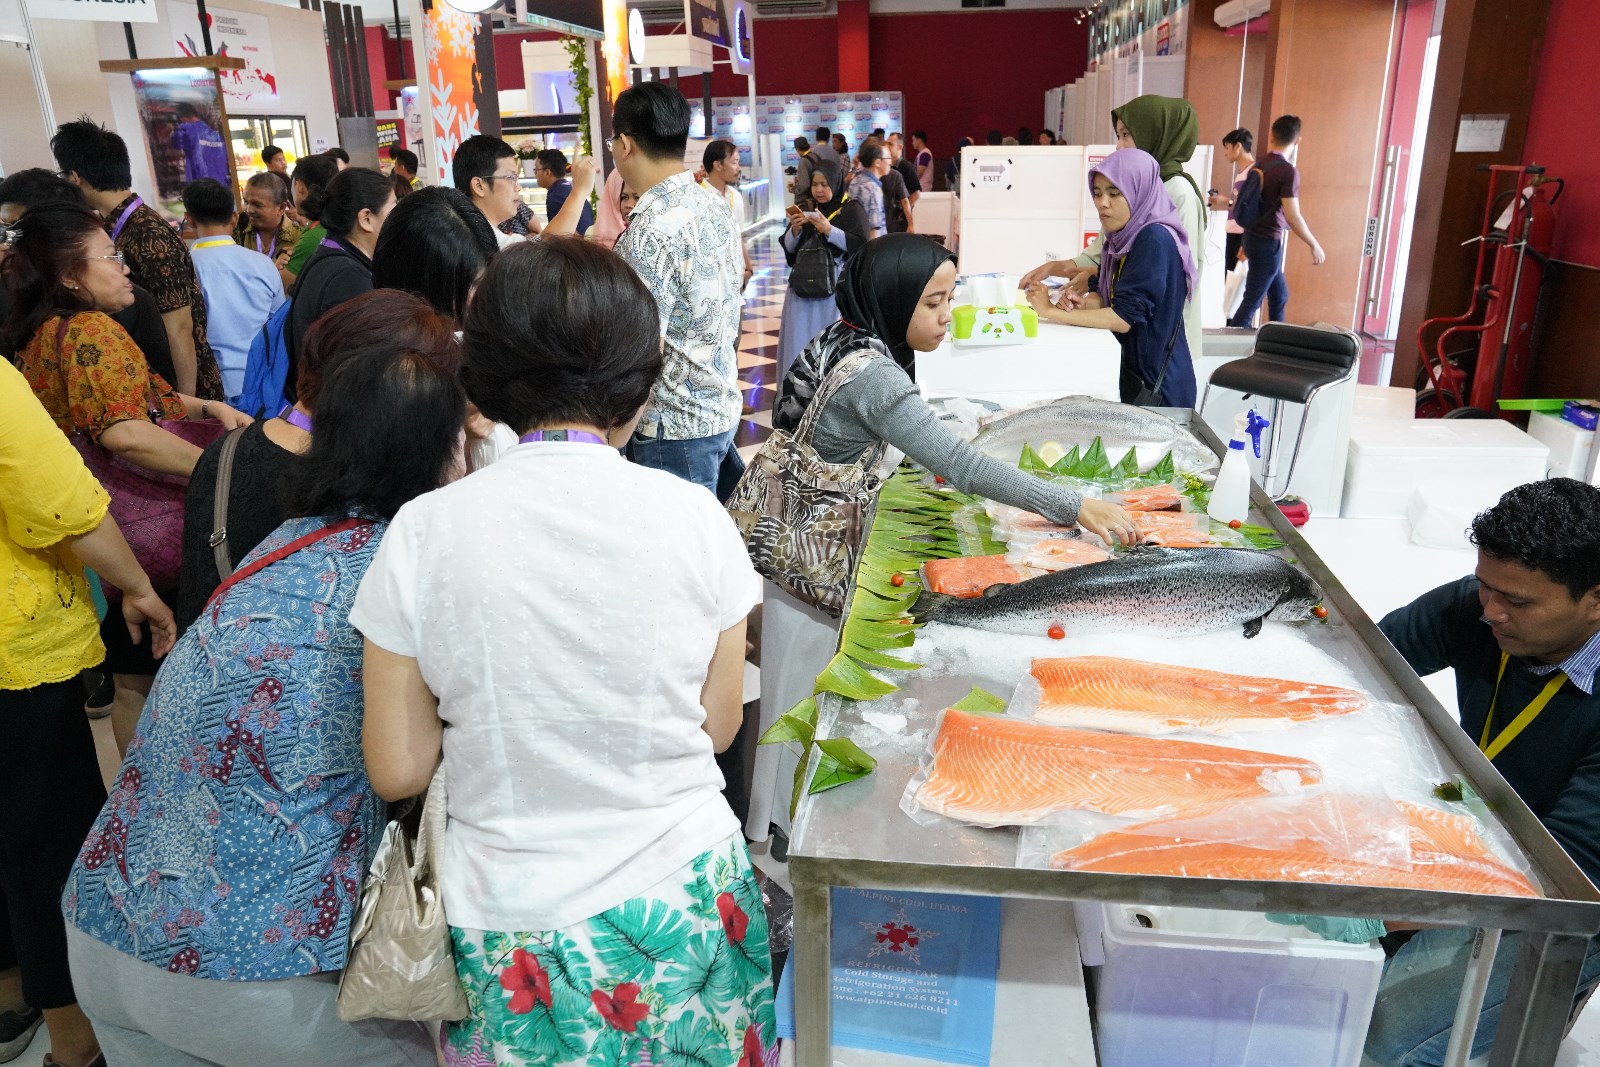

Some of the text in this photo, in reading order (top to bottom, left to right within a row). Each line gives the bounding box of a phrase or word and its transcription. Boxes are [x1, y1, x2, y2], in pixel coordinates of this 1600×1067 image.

[1366, 219, 1376, 255] DORONG
[930, 902, 968, 914] UTAMA
[844, 968, 869, 977] Cold
[871, 971, 914, 984] Storage
[847, 960, 938, 979] REFRIGOSTAR
[832, 985, 853, 993] one
[863, 989, 884, 997] +62
[887, 991, 900, 999] 21
[904, 993, 927, 1002] 626
[929, 996, 959, 1007] 8211
[908, 985, 949, 996] System
